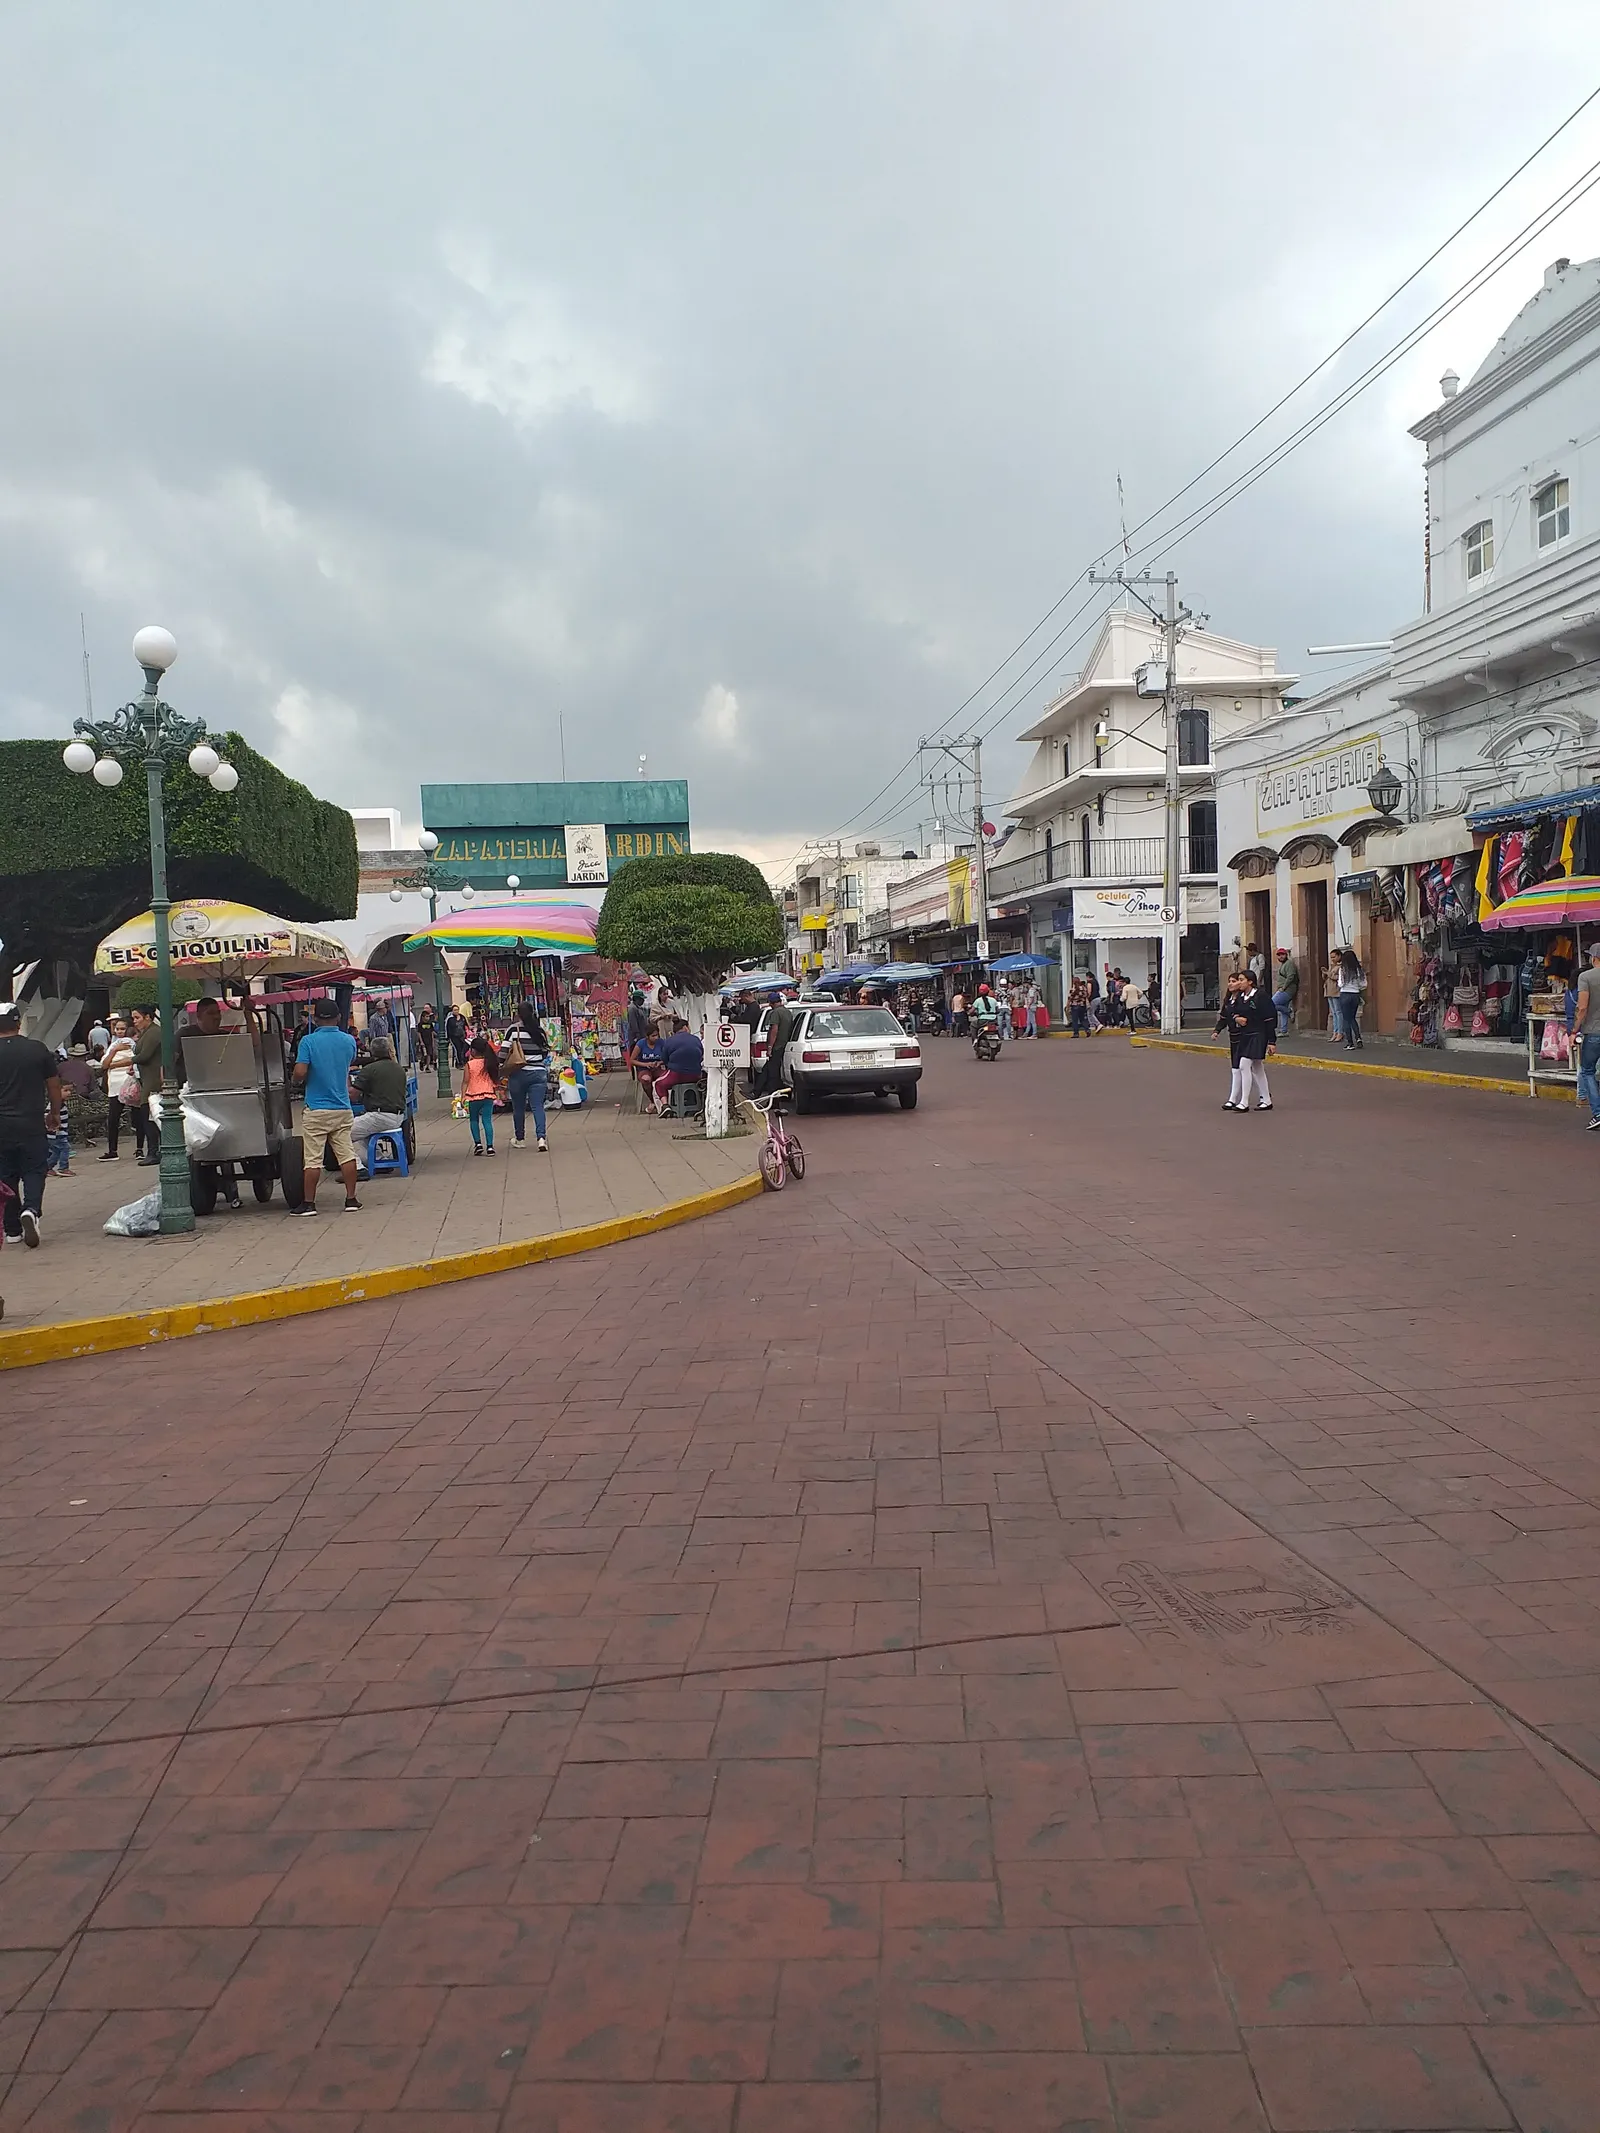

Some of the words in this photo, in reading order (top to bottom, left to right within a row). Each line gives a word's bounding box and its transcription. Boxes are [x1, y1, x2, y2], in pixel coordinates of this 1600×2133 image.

[1261, 743, 1378, 811] ZAPATERIA
[1303, 793, 1333, 819] LEON
[433, 838, 567, 861] ZAPATERIA
[571, 872, 605, 882] JARDIN
[1096, 891, 1131, 900] Celular
[1138, 902, 1160, 912] Shop
[110, 949, 140, 964] EL
[146, 937, 271, 961] CHIQUILIN
[712, 1048, 741, 1058] EXCLUSIVO
[719, 1058, 735, 1068] TAXIS
